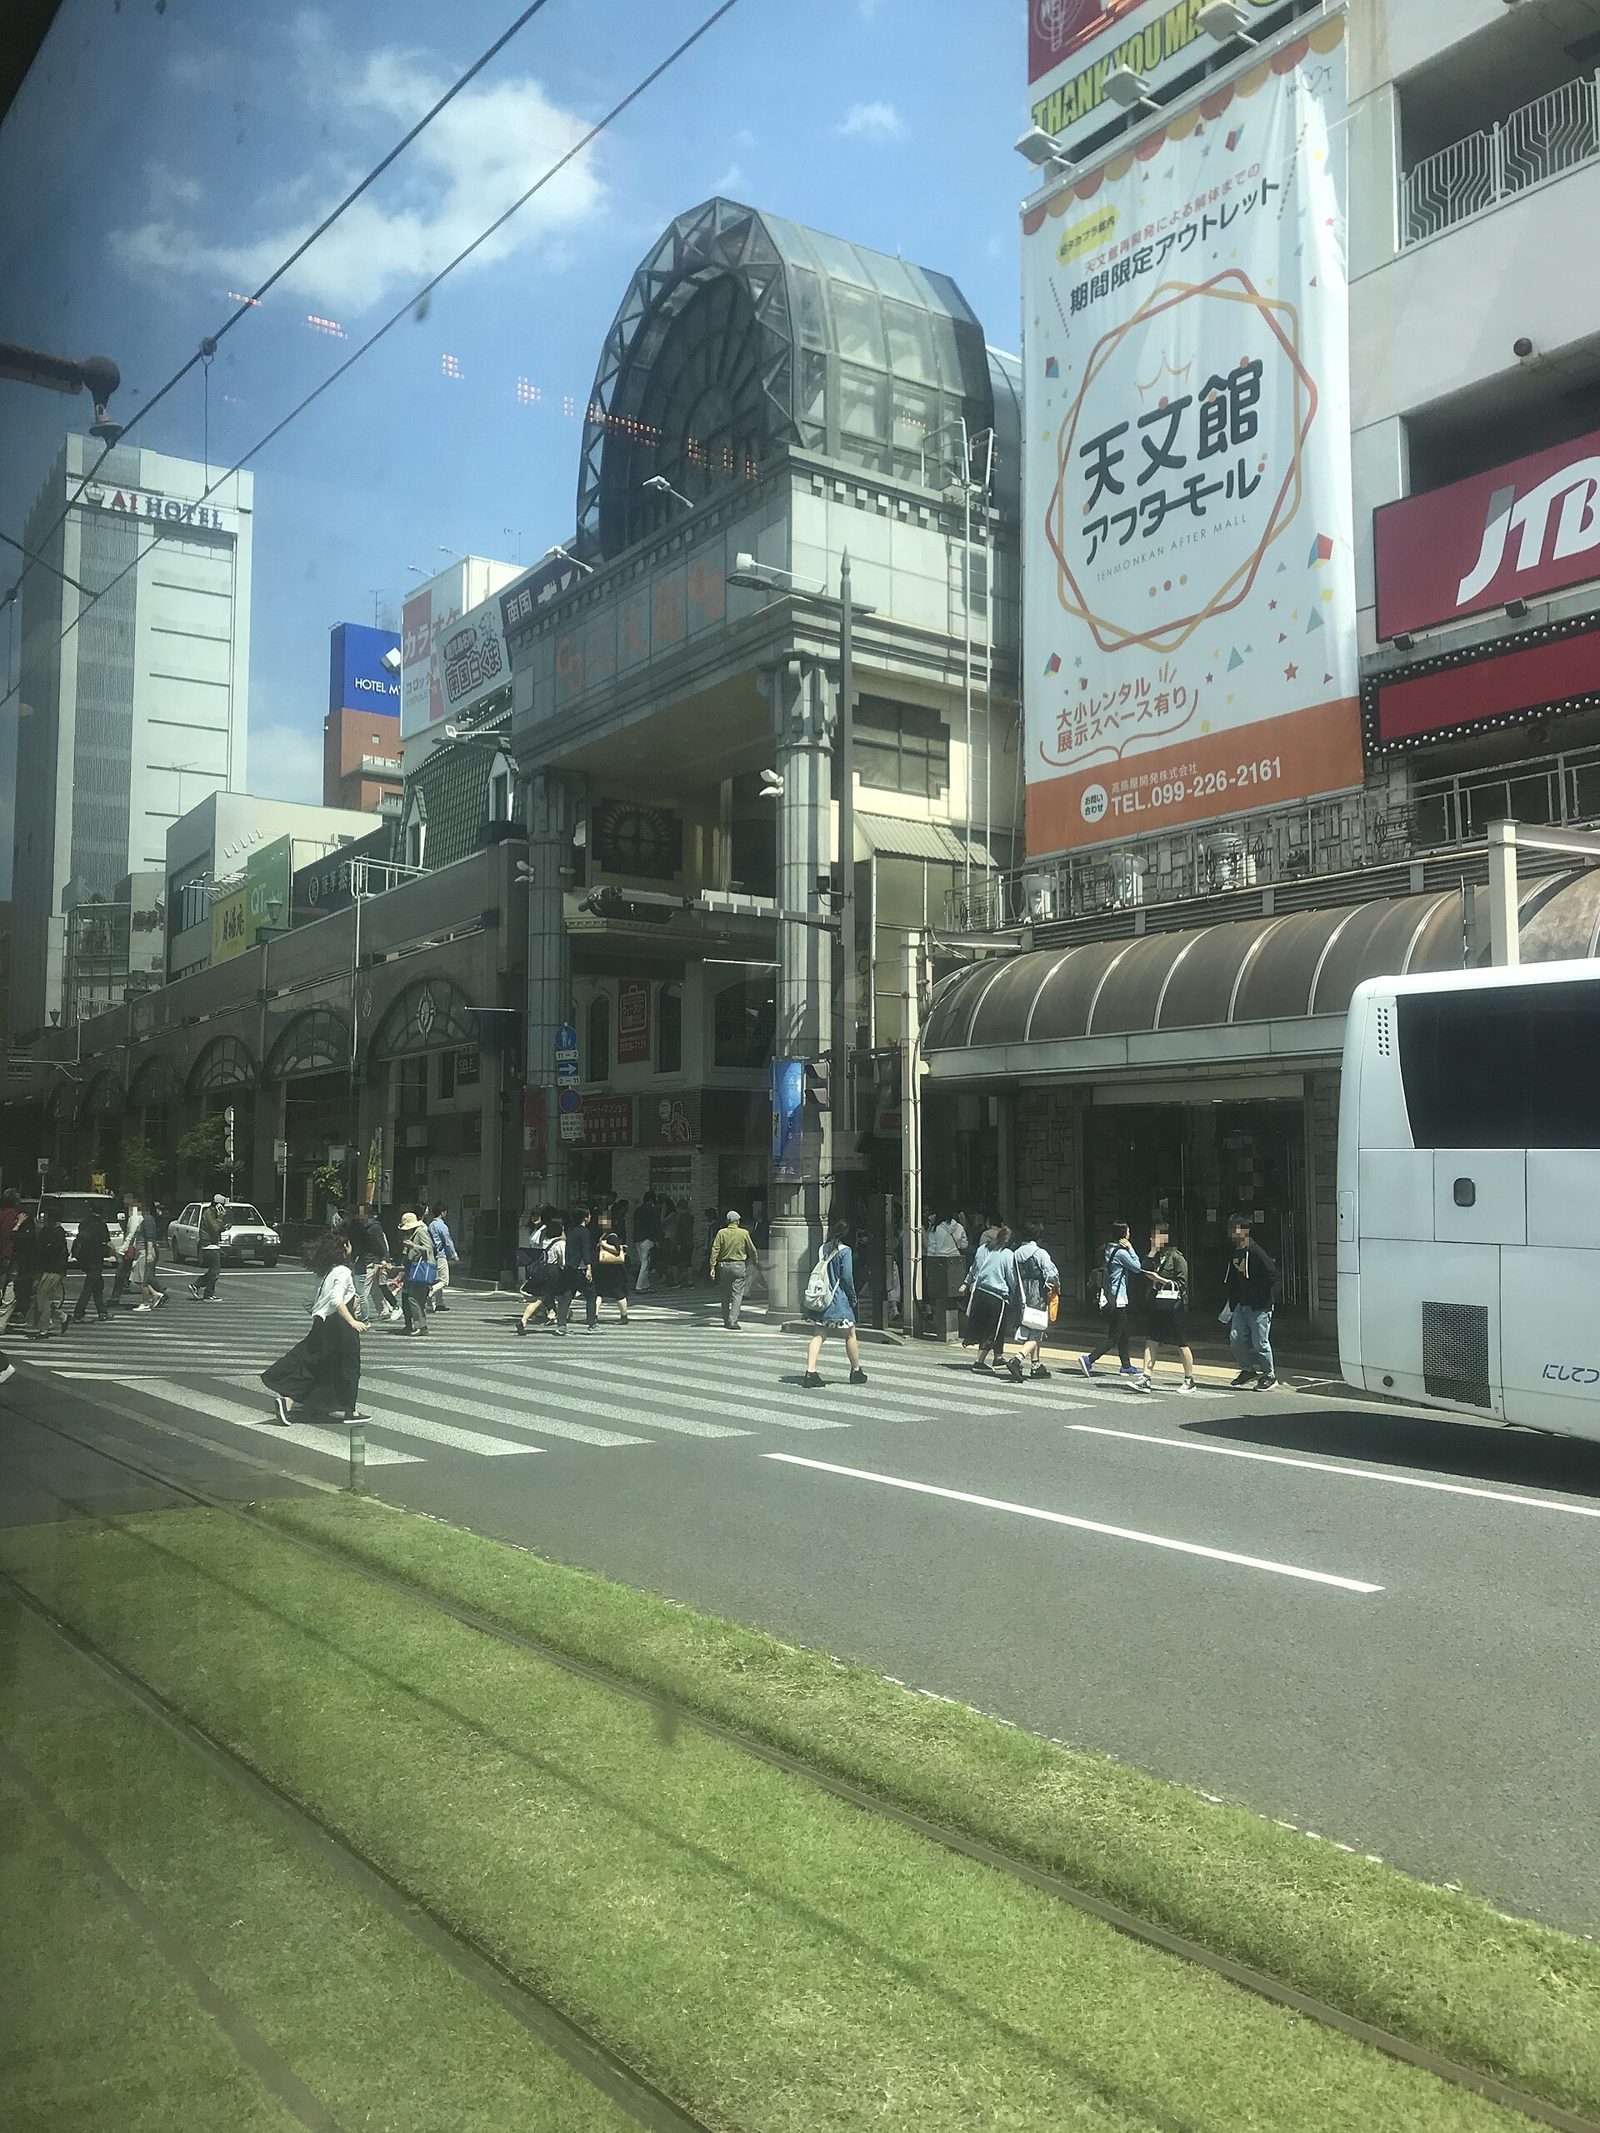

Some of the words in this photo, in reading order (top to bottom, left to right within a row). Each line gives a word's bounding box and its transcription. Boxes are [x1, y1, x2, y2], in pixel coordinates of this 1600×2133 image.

[1032, 52, 1111, 137] THANK
[1113, 17, 1160, 75] YOU
[1070, 177, 1280, 316] 期間限定アウトレット
[1079, 357, 1264, 515] 天文館
[145, 495, 223, 531] HOTEL
[1456, 456, 1600, 606] JTB
[1096, 546, 1165, 582] TENMONKAN
[1170, 528, 1207, 551] AFTER
[1213, 513, 1248, 534] MALL
[354, 677, 386, 693] HOTEL
[446, 641, 501, 701] 南国白くま
[1056, 677, 1151, 731] 大小レンタル
[1057, 685, 1187, 753] 展示スペース有り
[1111, 756, 1282, 817] TEL.099-226-2161
[1542, 1364, 1600, 1384] にしてつ
